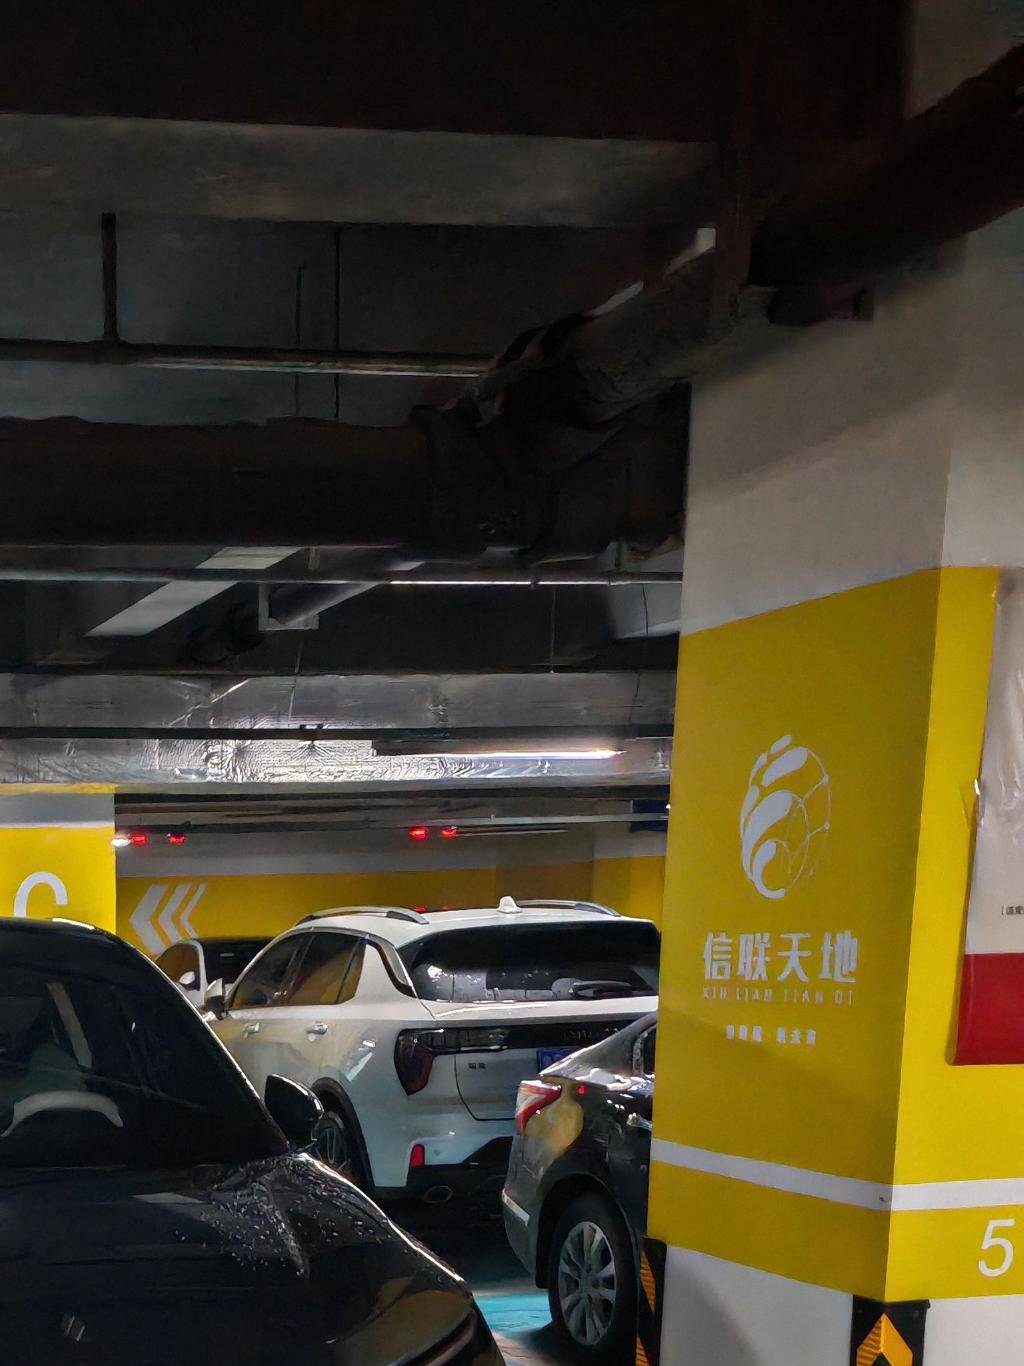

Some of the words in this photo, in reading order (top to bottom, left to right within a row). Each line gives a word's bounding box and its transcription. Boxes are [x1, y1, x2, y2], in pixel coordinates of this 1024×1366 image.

[703, 930, 858, 982] 信联天地
[978, 1218, 1015, 1278] 5
